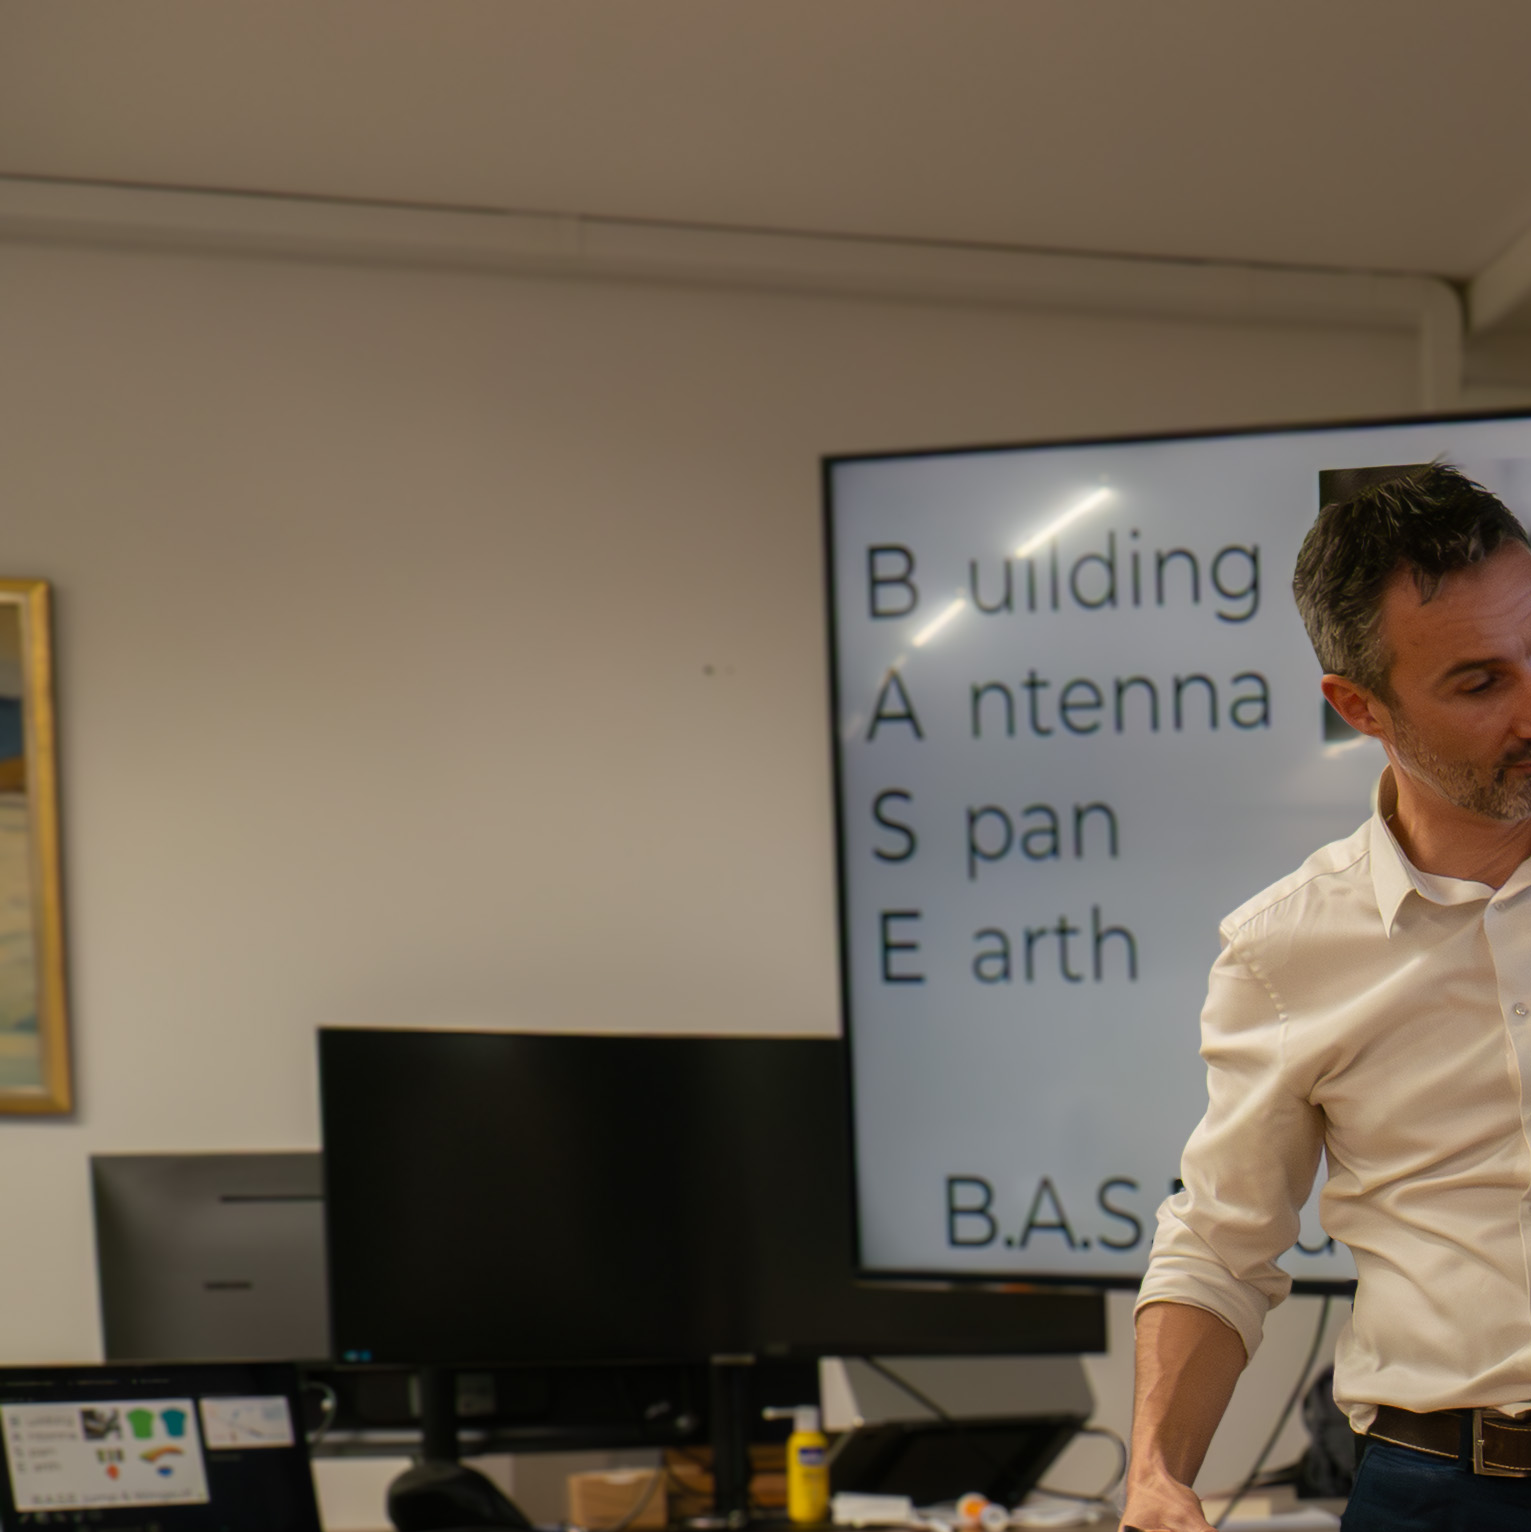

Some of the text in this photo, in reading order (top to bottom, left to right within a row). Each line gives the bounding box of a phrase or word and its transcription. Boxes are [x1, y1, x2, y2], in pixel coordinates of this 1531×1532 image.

[866, 527, 1261, 624] B uilding
[865, 667, 1271, 742] A ntenna
[871, 788, 1119, 882] S pan
[879, 905, 1138, 985] E arth
[946, 1174, 1185, 1251] B.A.S
